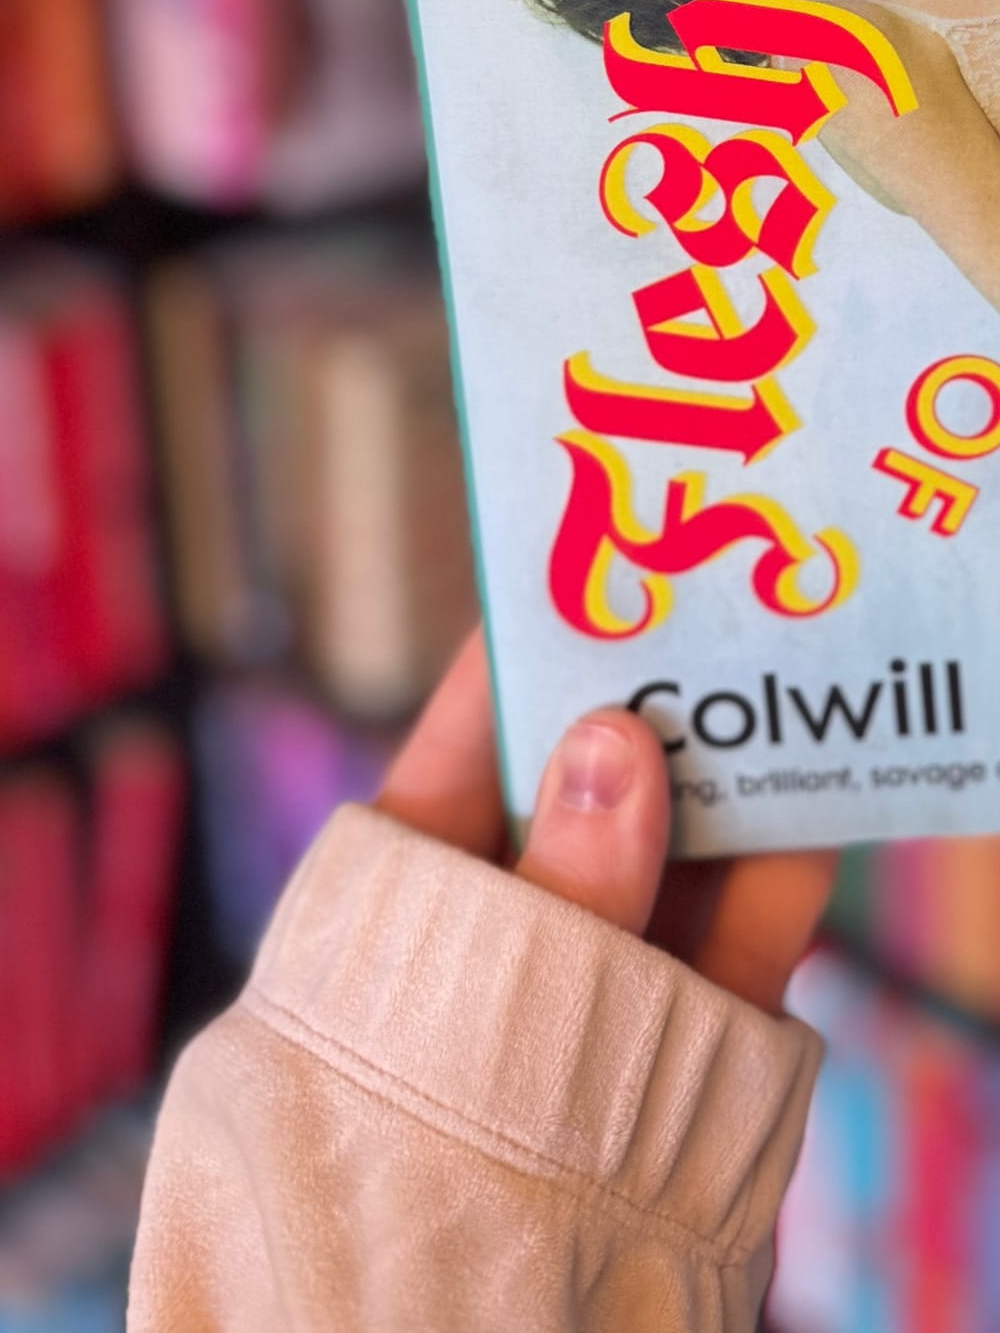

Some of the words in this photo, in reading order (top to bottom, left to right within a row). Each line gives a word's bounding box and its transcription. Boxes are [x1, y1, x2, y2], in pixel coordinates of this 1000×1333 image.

[627, 657, 965, 755] Colwill
[736, 768, 863, 797] brilliant,
[869, 760, 986, 791] savage
